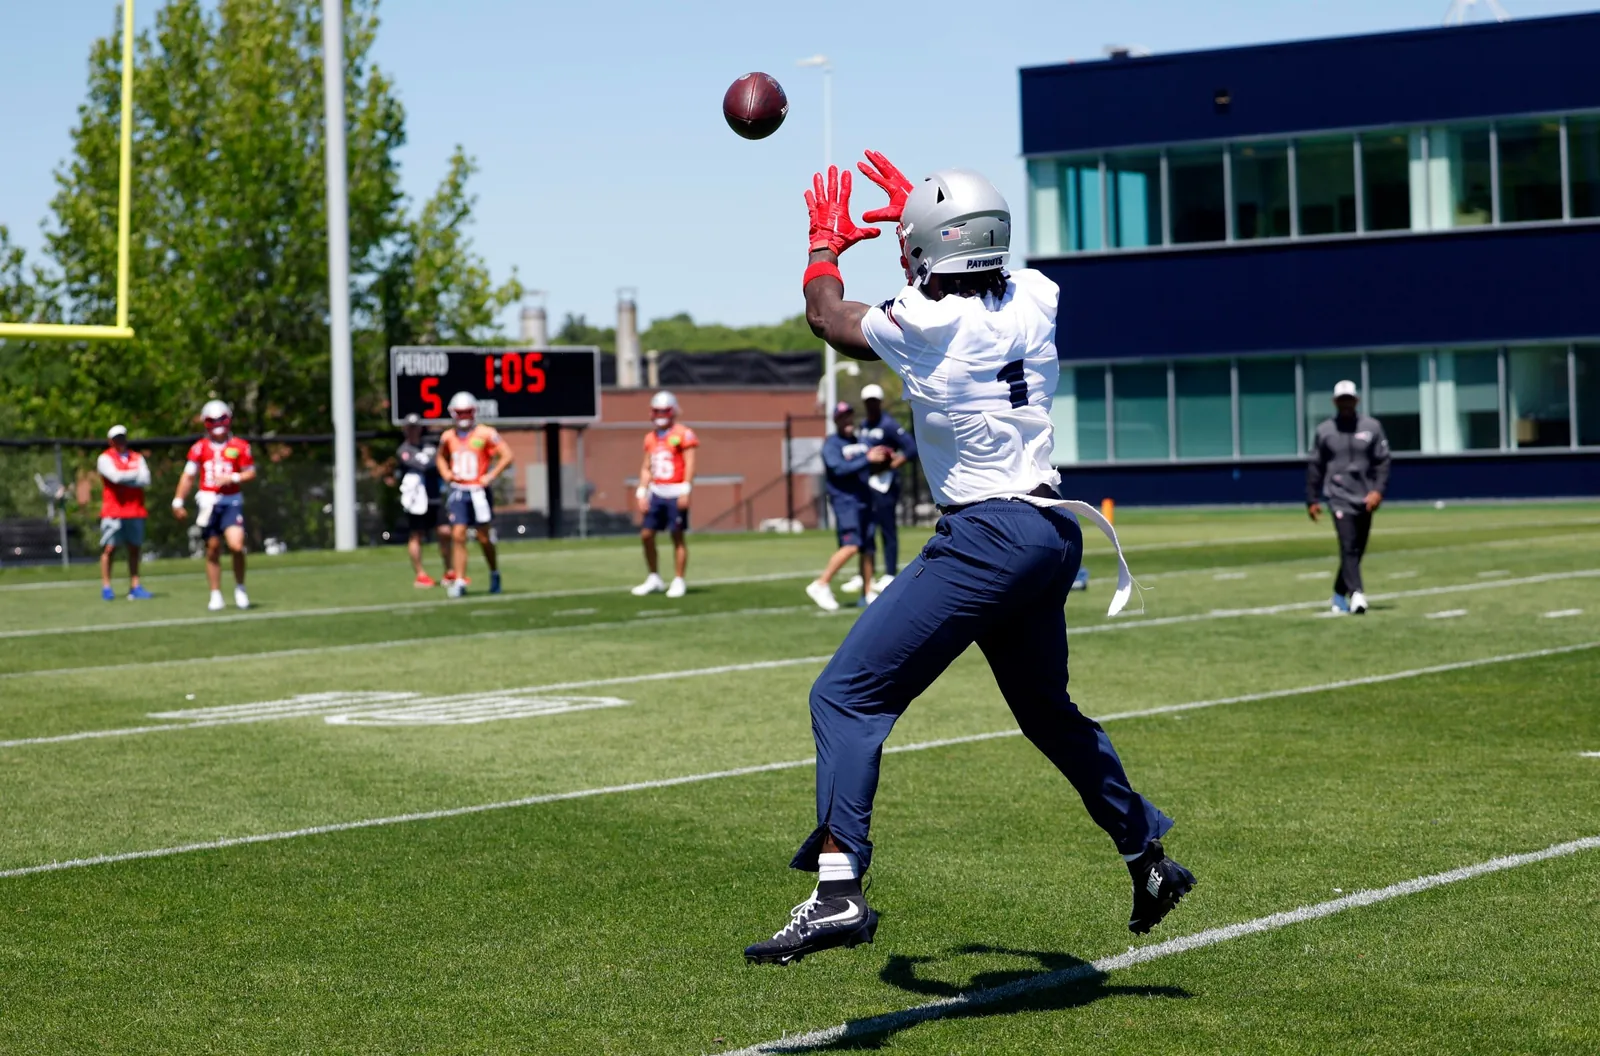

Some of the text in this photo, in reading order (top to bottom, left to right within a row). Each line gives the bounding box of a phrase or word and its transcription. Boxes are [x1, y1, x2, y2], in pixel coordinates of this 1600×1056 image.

[989, 229, 994, 246] 1
[966, 256, 1003, 269] PATRIOTS
[396, 352, 449, 376] PERIOD
[485, 352, 547, 393] 1:05
[420, 377, 442, 418] 5
[996, 359, 1029, 409] 1
[451, 451, 478, 480] 10
